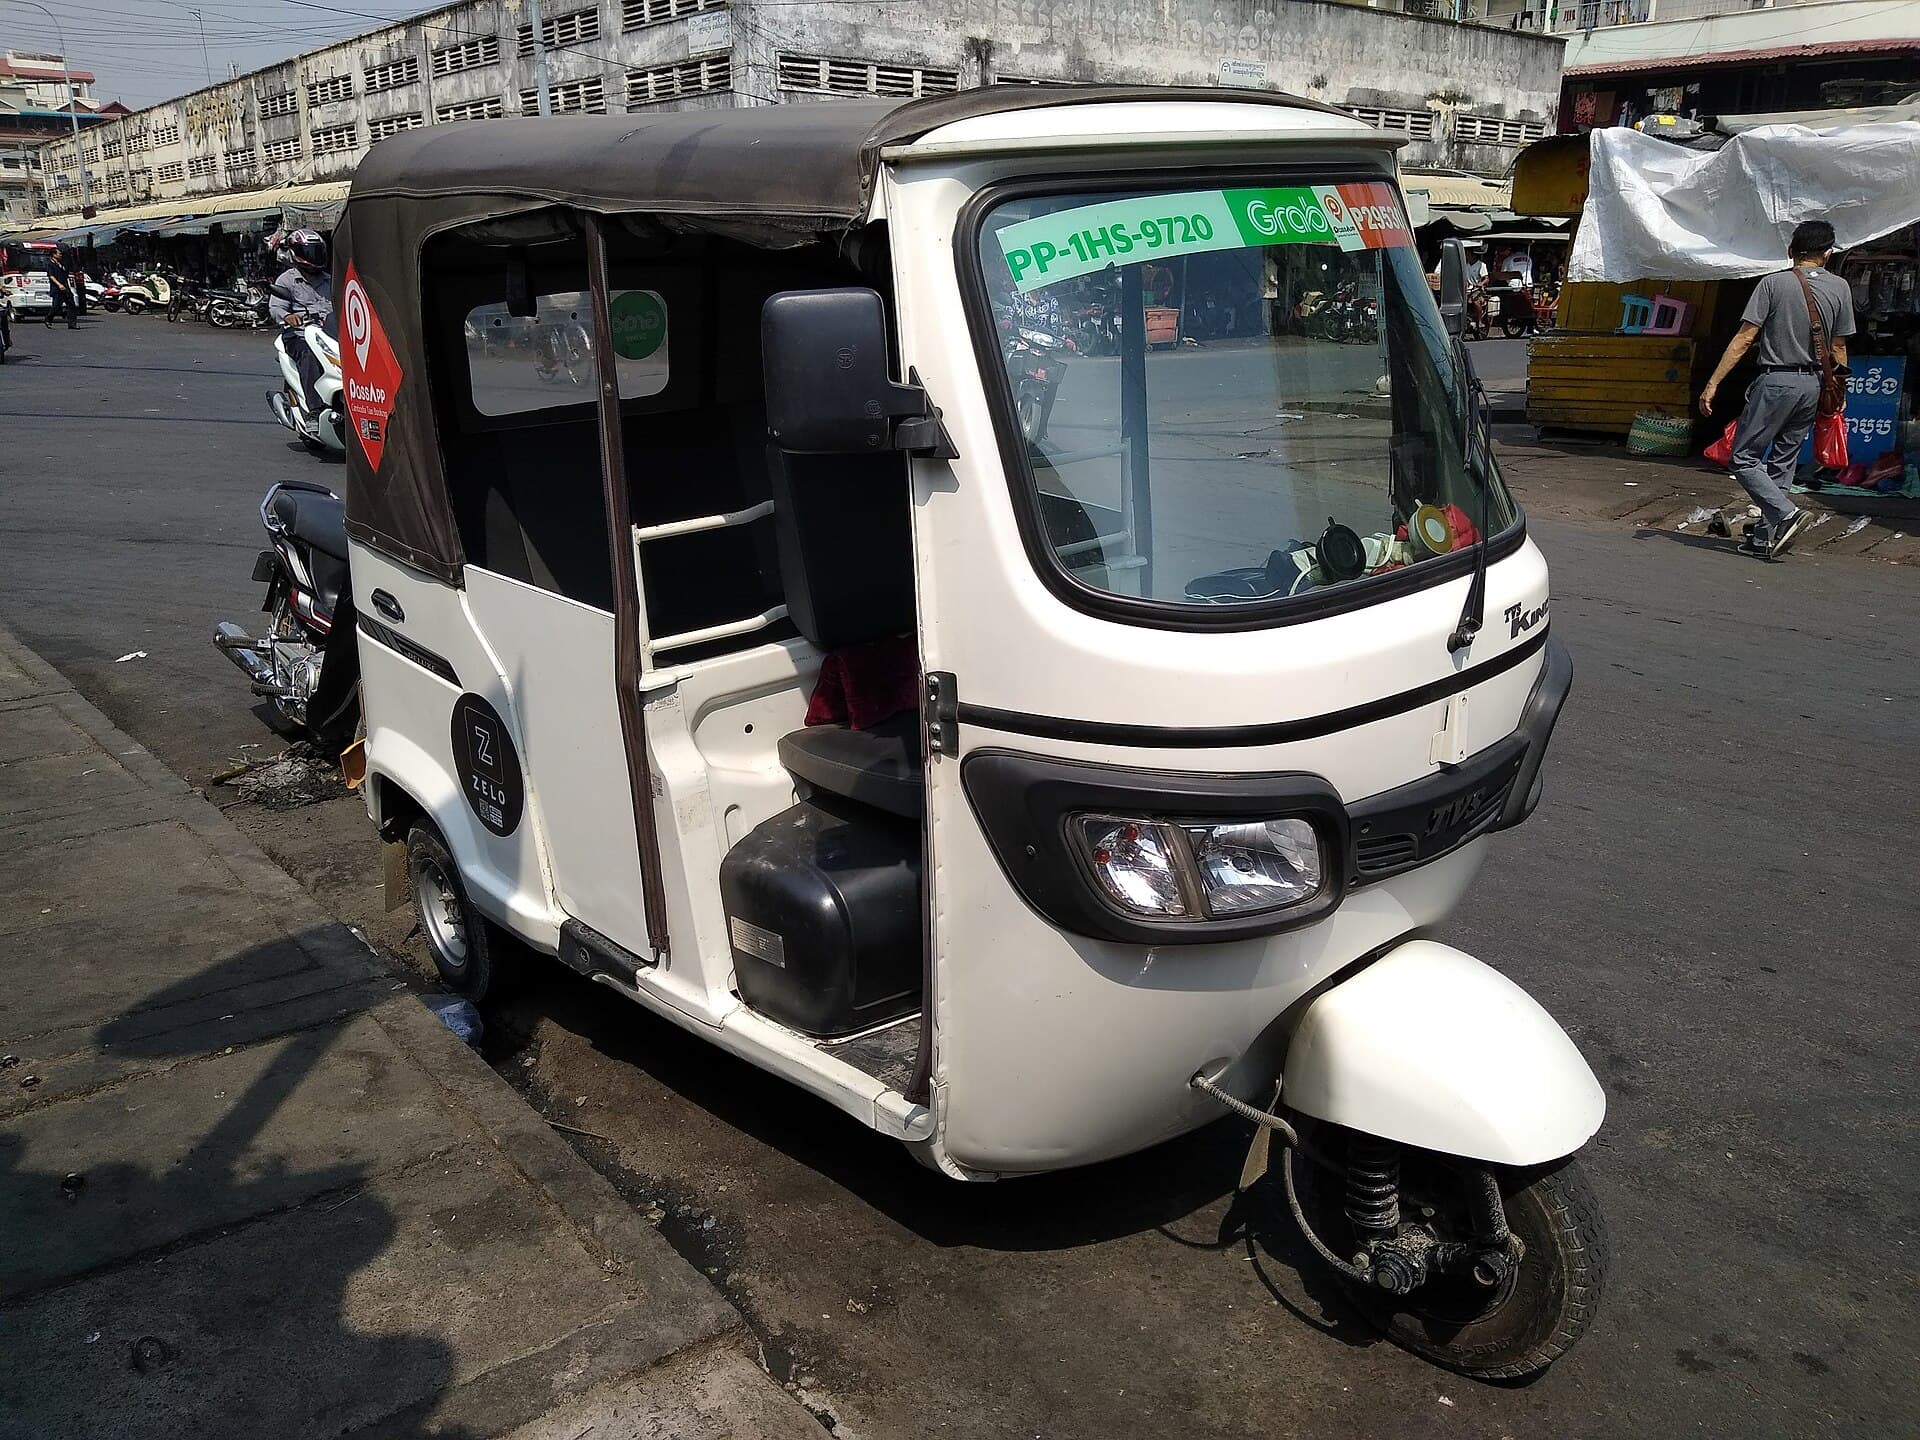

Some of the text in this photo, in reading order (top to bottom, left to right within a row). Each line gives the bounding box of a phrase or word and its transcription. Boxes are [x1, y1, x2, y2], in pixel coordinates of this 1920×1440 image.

[1246, 196, 1328, 236] Grab
[1005, 214, 1214, 282] PP-1HS-9720
[349, 378, 386, 404] PassApp
[407, 652, 437, 671] DELUXE
[471, 775, 507, 806] ZELO
